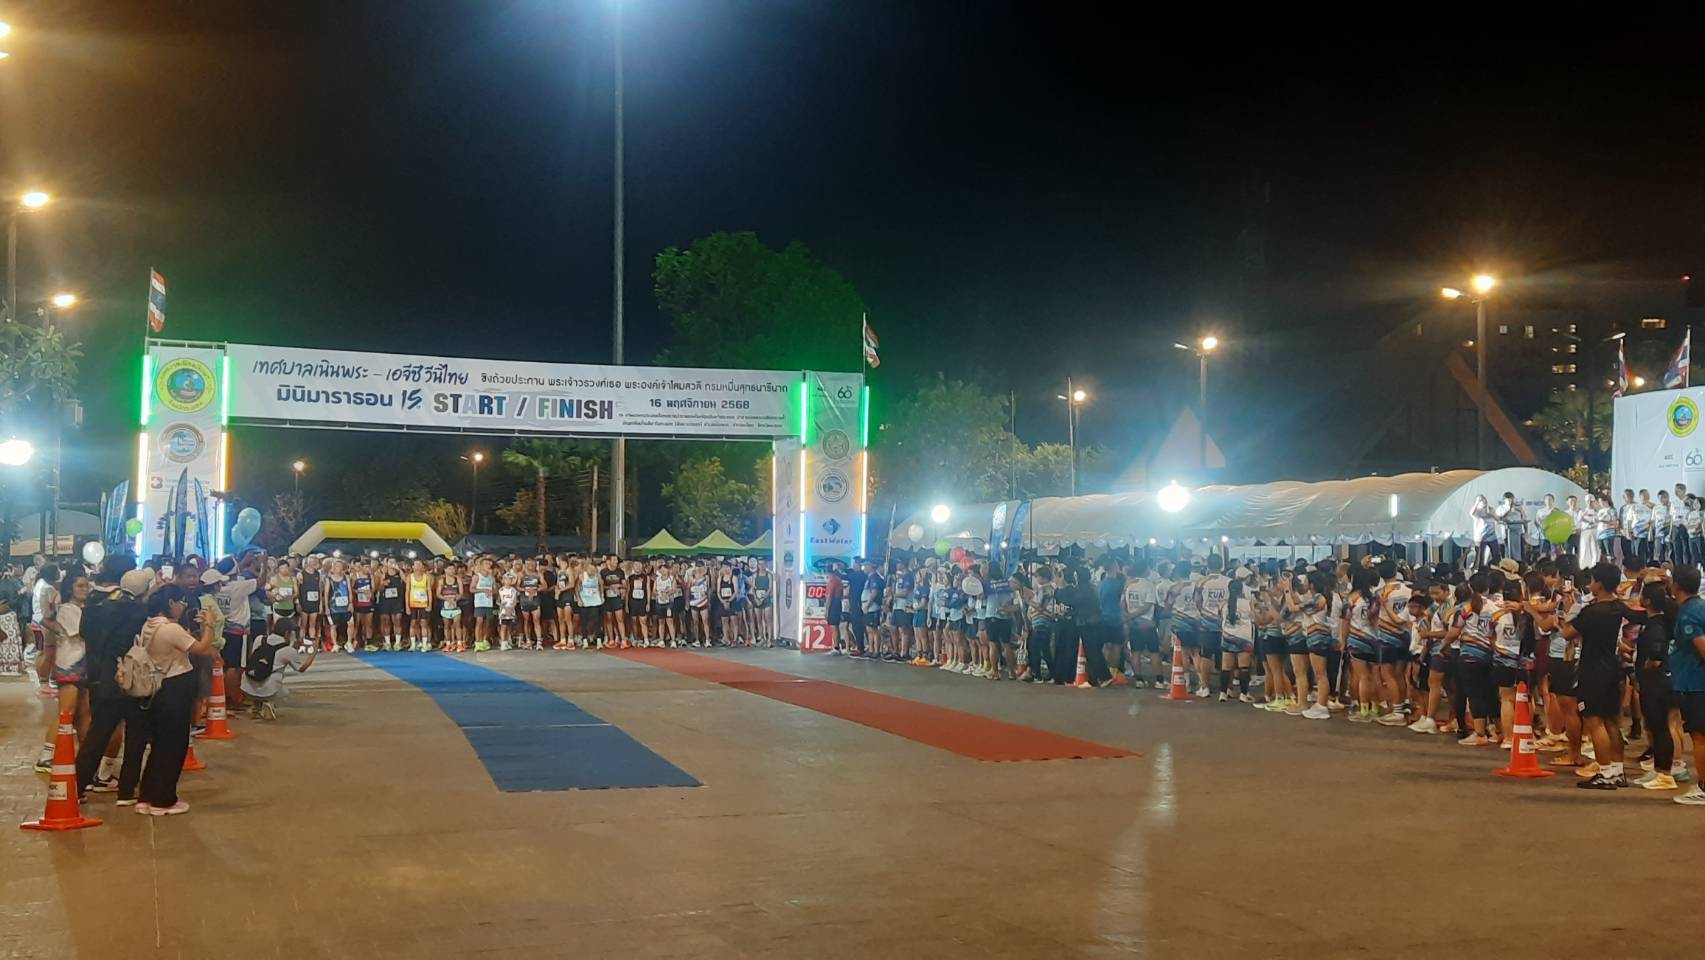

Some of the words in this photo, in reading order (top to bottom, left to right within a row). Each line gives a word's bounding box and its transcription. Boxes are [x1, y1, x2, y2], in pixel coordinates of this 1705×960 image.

[276, 384, 393, 407] มินิมาราธอน
[433, 393, 507, 416] START
[537, 398, 614, 420] FINISH
[649, 398, 662, 408] 16
[721, 400, 750, 410] 2568
[802, 625, 826, 649] 12
